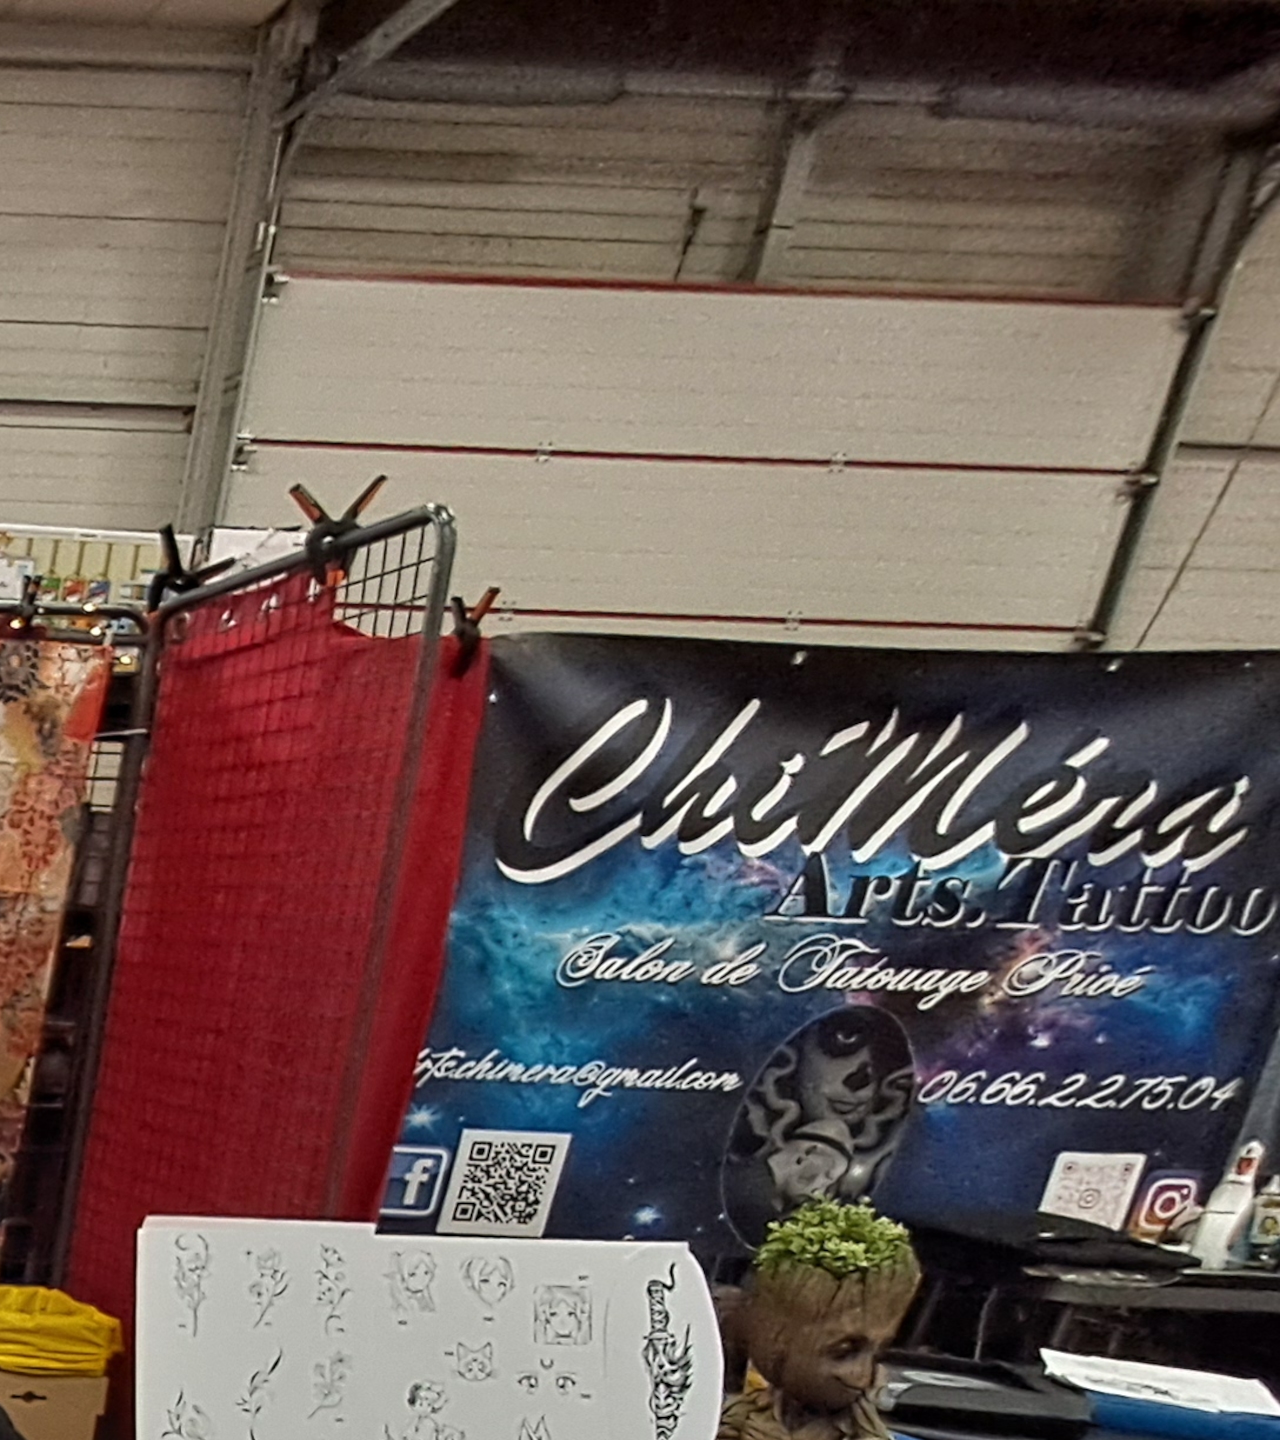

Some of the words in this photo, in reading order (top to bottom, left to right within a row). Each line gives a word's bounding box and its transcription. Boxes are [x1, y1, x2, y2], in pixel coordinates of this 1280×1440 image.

[555, 933, 692, 987] Salon
[701, 937, 762, 987] de
[778, 934, 992, 1010] Tatouage
[1003, 950, 1153, 1000] Privé
